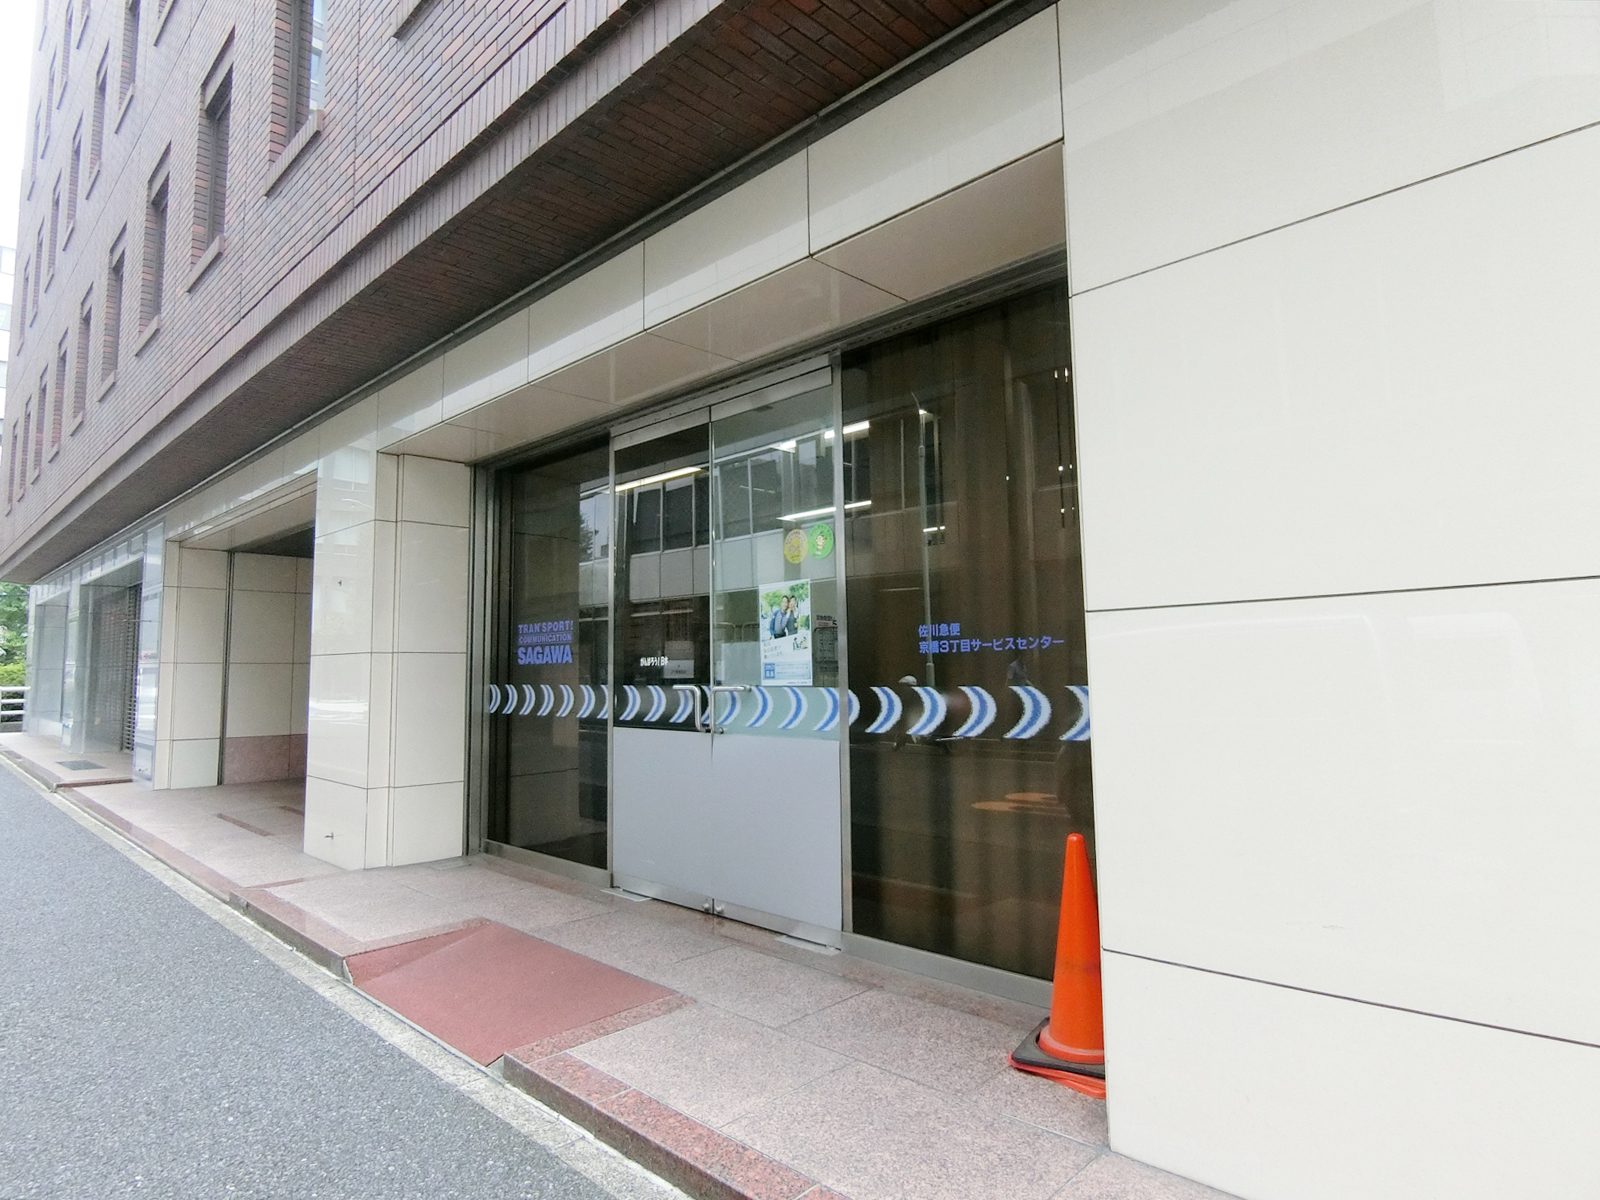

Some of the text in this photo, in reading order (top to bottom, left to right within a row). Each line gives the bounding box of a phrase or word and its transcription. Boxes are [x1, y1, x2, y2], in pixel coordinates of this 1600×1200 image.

[918, 623, 961, 637] 佐川急便
[919, 636, 1064, 654] 京橋3丁目サービスセンター
[517, 645, 573, 665] SAGAWA
